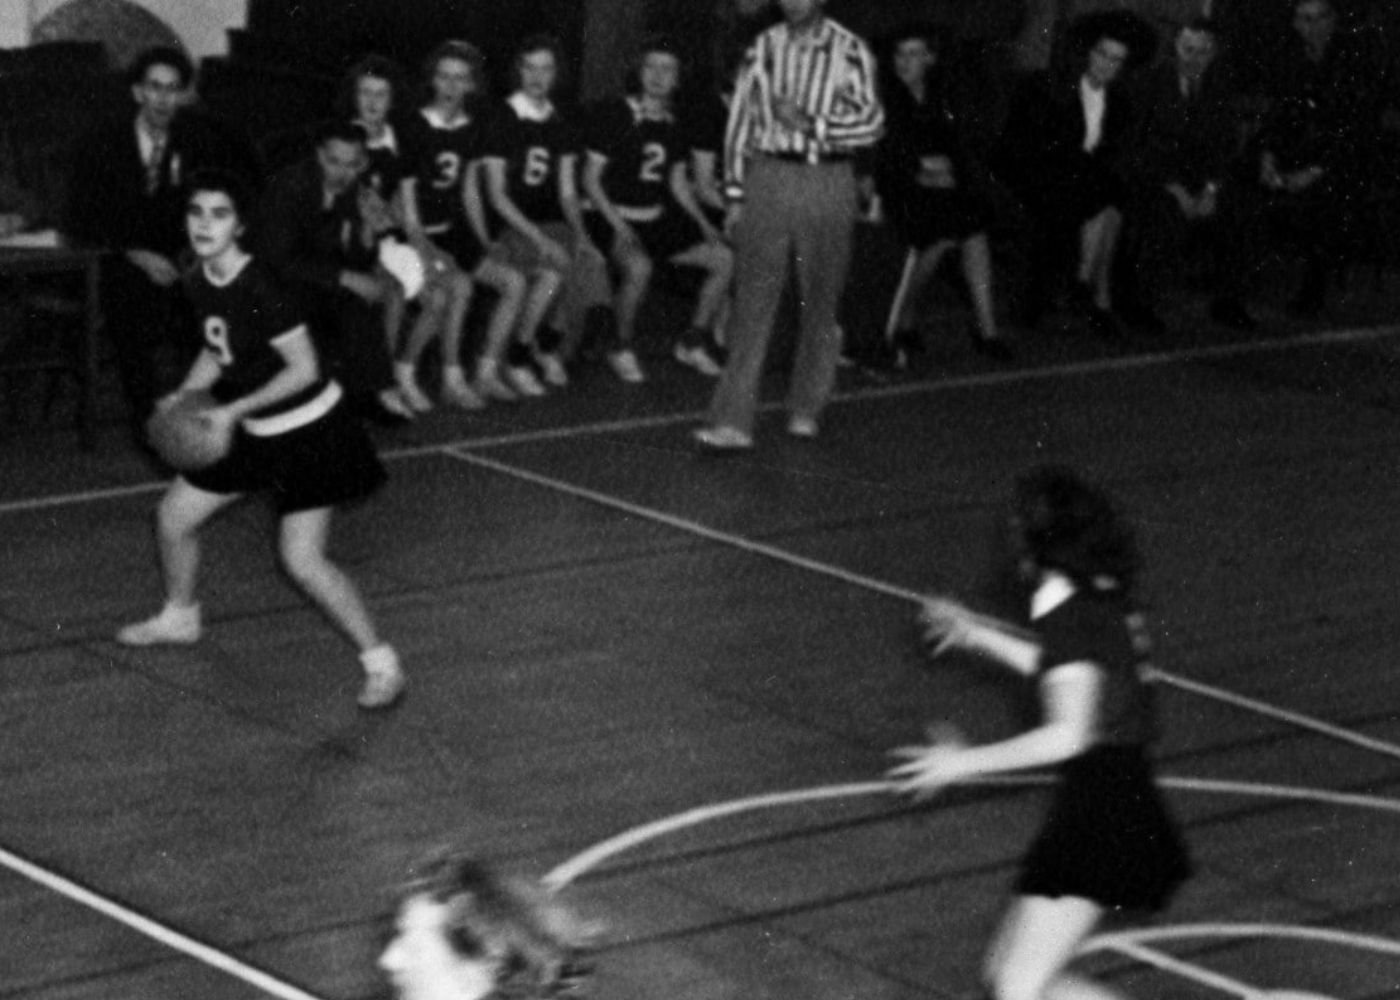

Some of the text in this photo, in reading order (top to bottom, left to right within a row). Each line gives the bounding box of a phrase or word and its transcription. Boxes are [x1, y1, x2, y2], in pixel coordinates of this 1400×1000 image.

[432, 151, 459, 188] 3
[524, 146, 550, 186] 6
[641, 142, 666, 181] 2
[204, 315, 232, 366] 9
